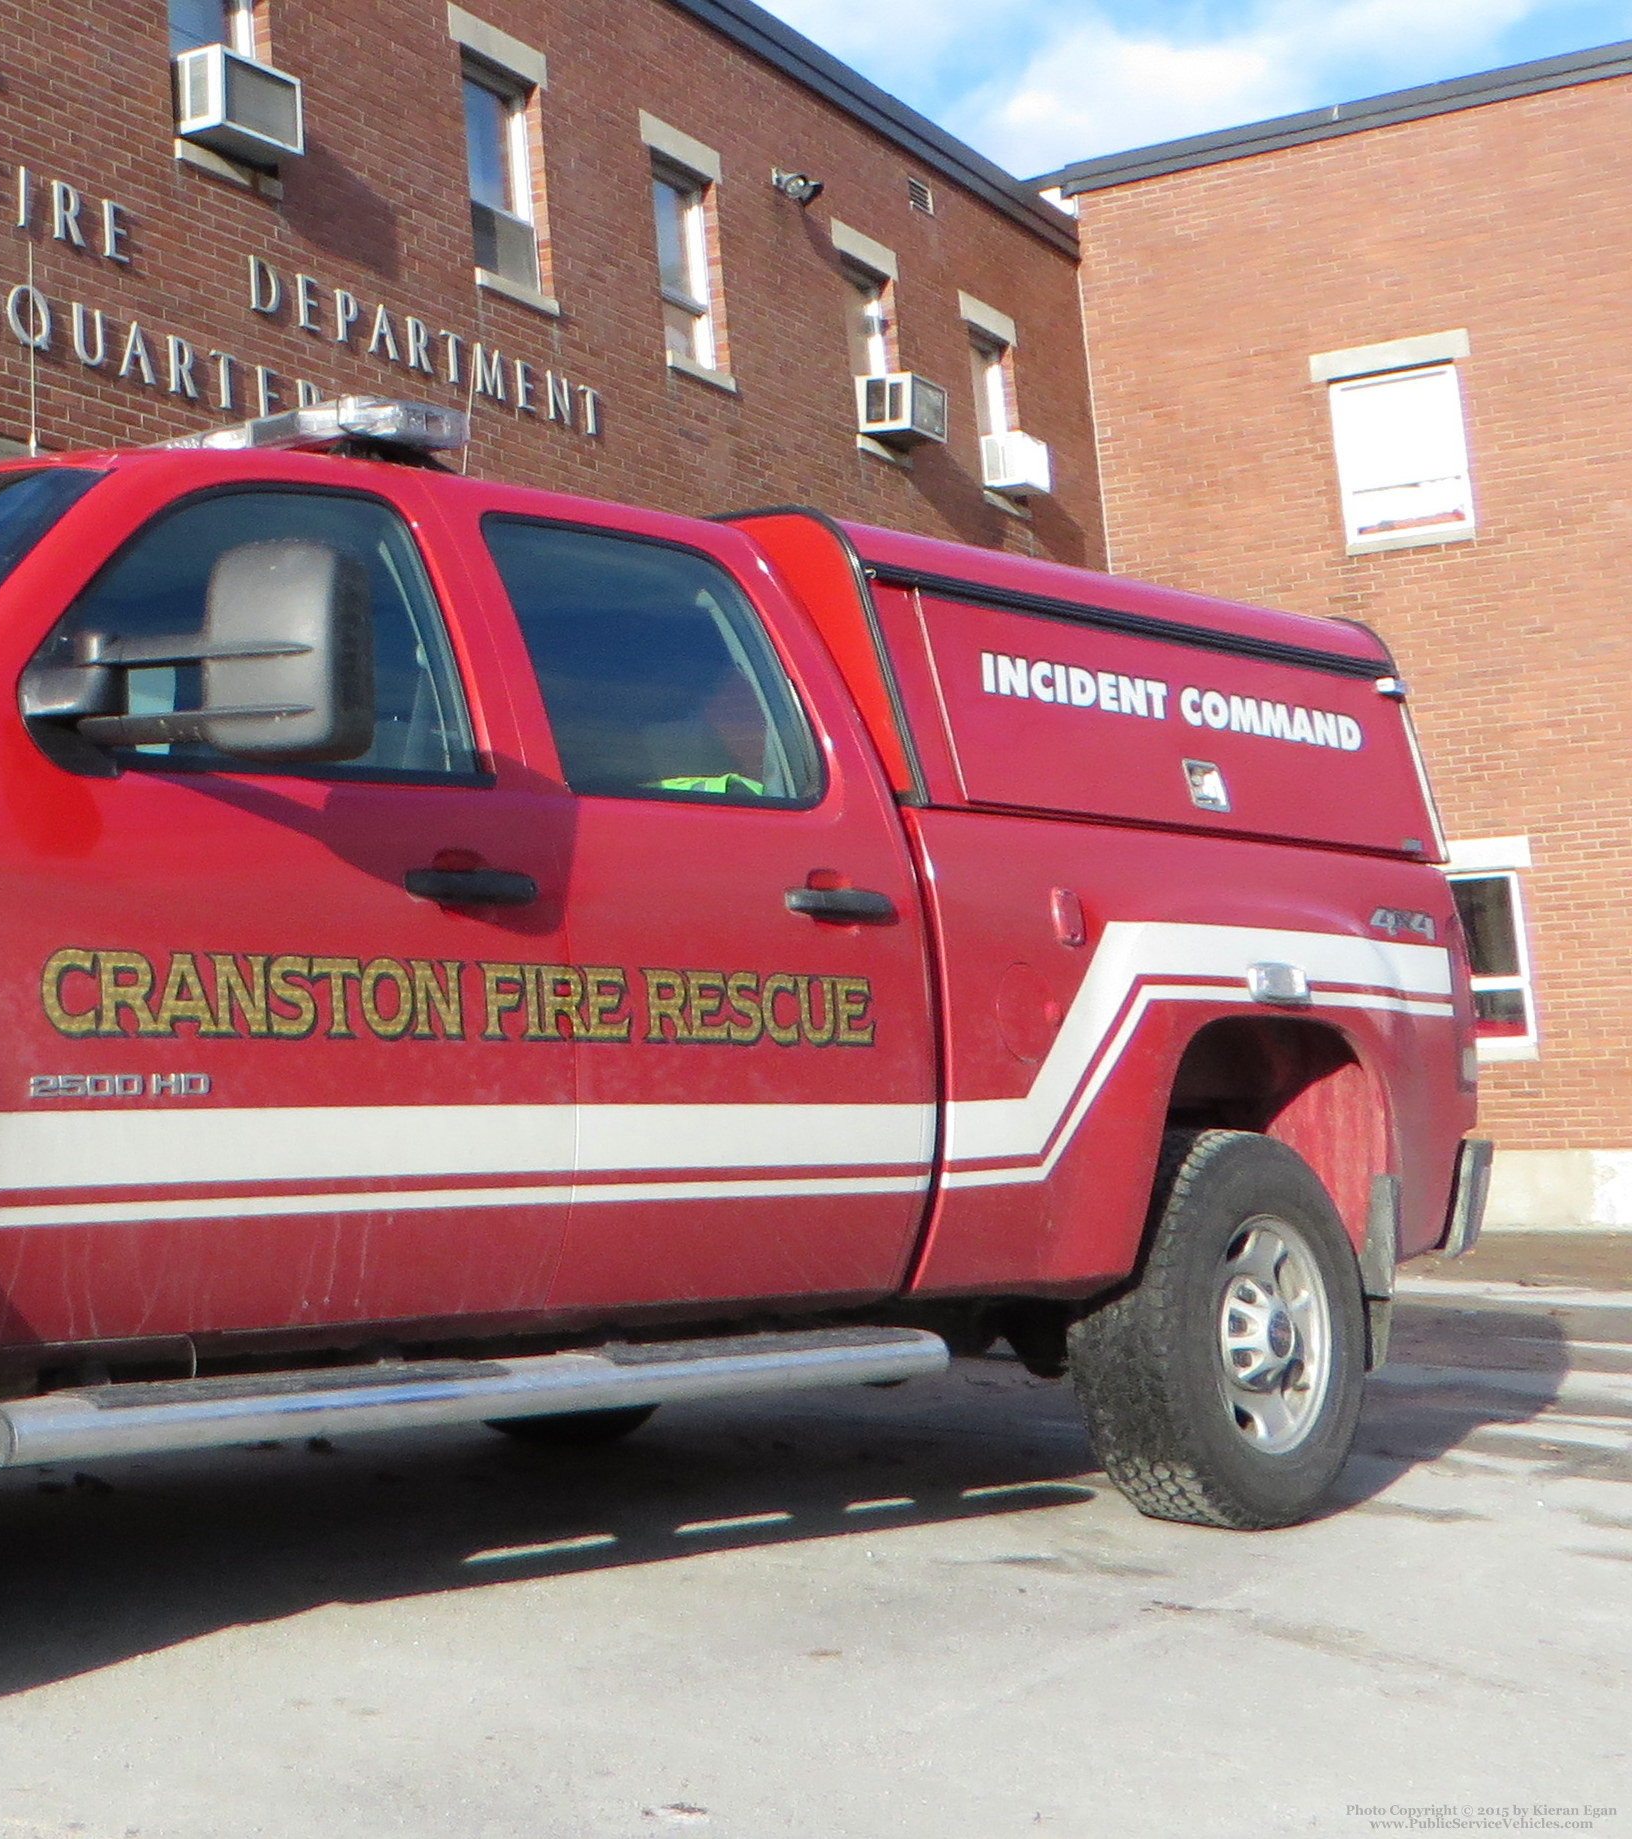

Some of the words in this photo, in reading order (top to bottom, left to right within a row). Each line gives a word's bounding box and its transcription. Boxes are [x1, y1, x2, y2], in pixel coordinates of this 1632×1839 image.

[247, 255, 599, 436] DEPARTMENT
[979, 652, 1168, 720] INCIDENT
[1179, 686, 1362, 752] COMMAND
[40, 947, 465, 1042] CRANSTON
[481, 960, 635, 1044] FIRE
[643, 967, 877, 1048] RESCUE
[30, 1073, 145, 1098] 2500
[151, 1072, 211, 1096] HD
